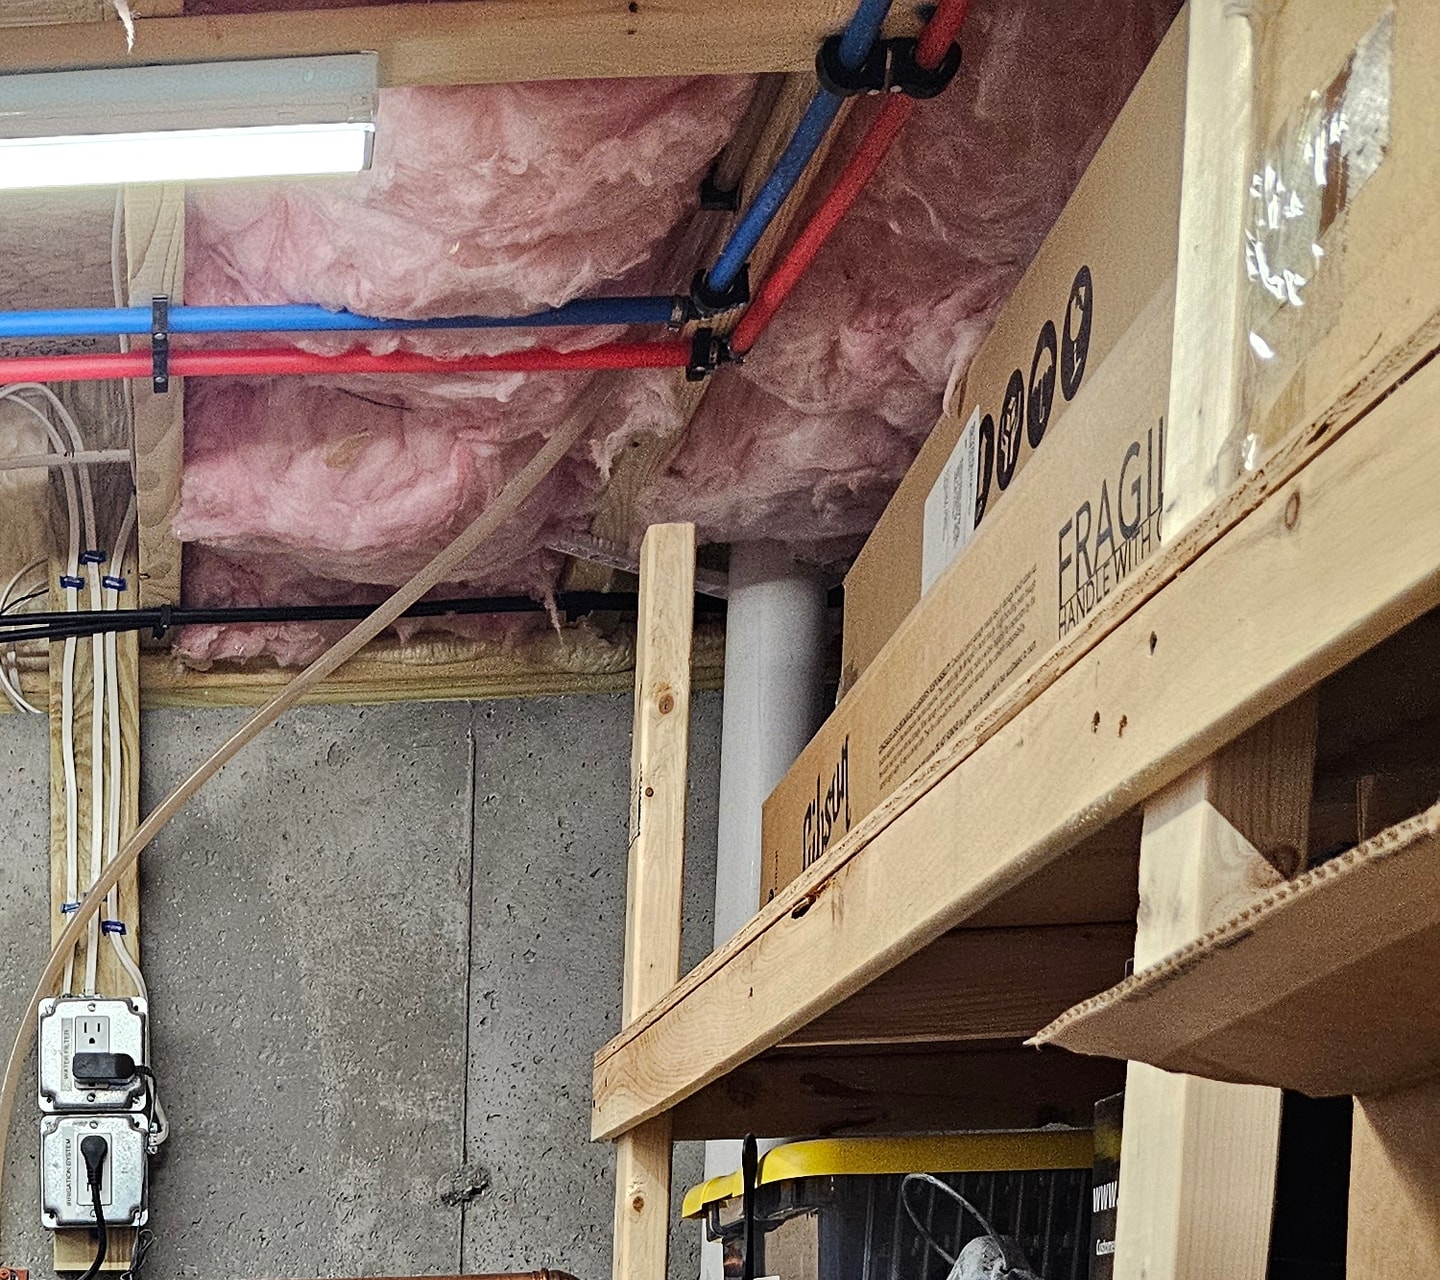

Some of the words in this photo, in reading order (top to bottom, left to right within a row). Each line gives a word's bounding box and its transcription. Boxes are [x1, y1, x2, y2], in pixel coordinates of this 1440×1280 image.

[1059, 416, 1164, 610] FRAGIL
[1059, 560, 1111, 641] HANDLE
[1112, 517, 1151, 584] WITH
